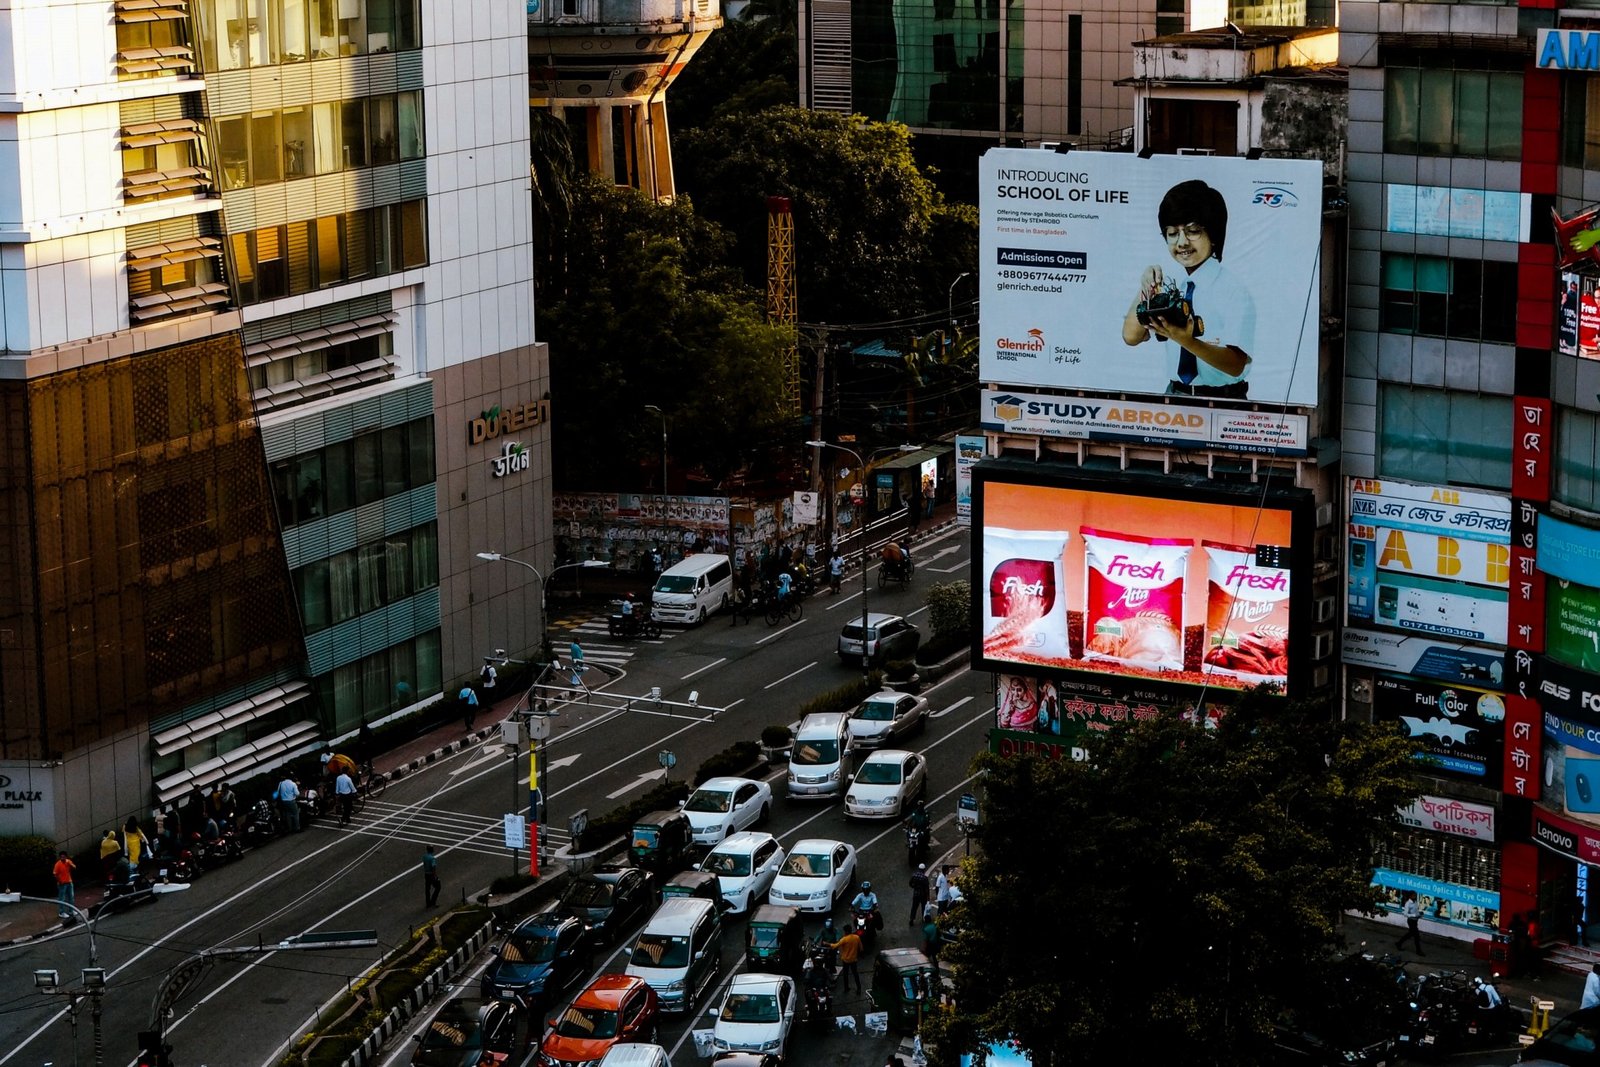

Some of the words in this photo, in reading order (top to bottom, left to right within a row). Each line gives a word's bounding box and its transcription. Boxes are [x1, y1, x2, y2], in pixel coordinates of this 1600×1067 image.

[998, 169, 1089, 184] INTRODUCING
[998, 185, 1064, 201] SCHOOL
[1069, 188, 1091, 202] OF
[1095, 189, 1129, 204] LIFE
[1252, 193, 1283, 205] STS
[997, 209, 1019, 217] Offering
[1044, 211, 1068, 219] Robotics
[1069, 212, 1099, 220] Curriculum
[1001, 252, 1054, 264] Admissions
[1057, 255, 1083, 266] Open
[998, 270, 1087, 283] +8809677444777
[997, 282, 1062, 293] glenrich.edu.bd
[1581, 302, 1598, 315] Free
[997, 338, 1042, 351] Glenrich
[1054, 346, 1082, 355] School
[1054, 355, 1063, 364] of
[1065, 356, 1081, 364] Life
[1027, 401, 1101, 419] STUDY
[1106, 408, 1204, 428] ABROAD
[1050, 418, 1084, 426] Worldwide
[1085, 421, 1120, 429] Admission
[1353, 479, 1382, 495] ABB
[1431, 488, 1461, 505] ABB
[1354, 499, 1376, 514] NZE
[1378, 503, 1406, 518] এন
[1408, 506, 1446, 523] জেড
[1349, 525, 1375, 540] ABB
[1107, 555, 1165, 581] Fresh
[1225, 565, 1287, 592] Fresh
[1107, 585, 1150, 609] Atta
[1231, 600, 1274, 623] Maida
[1402, 621, 1481, 639] 01714-093601
[1540, 680, 1571, 701] ASUS
[1544, 711, 1560, 729] FIND
[1561, 719, 1585, 739] YOUR
[5, 791, 42, 801] PLAZA
[1432, 820, 1478, 836] Optics
[1537, 821, 1573, 849] Lenovo
[1432, 884, 1454, 896] Optics
[1463, 890, 1475, 901] Eye
[1476, 894, 1492, 905] Care
